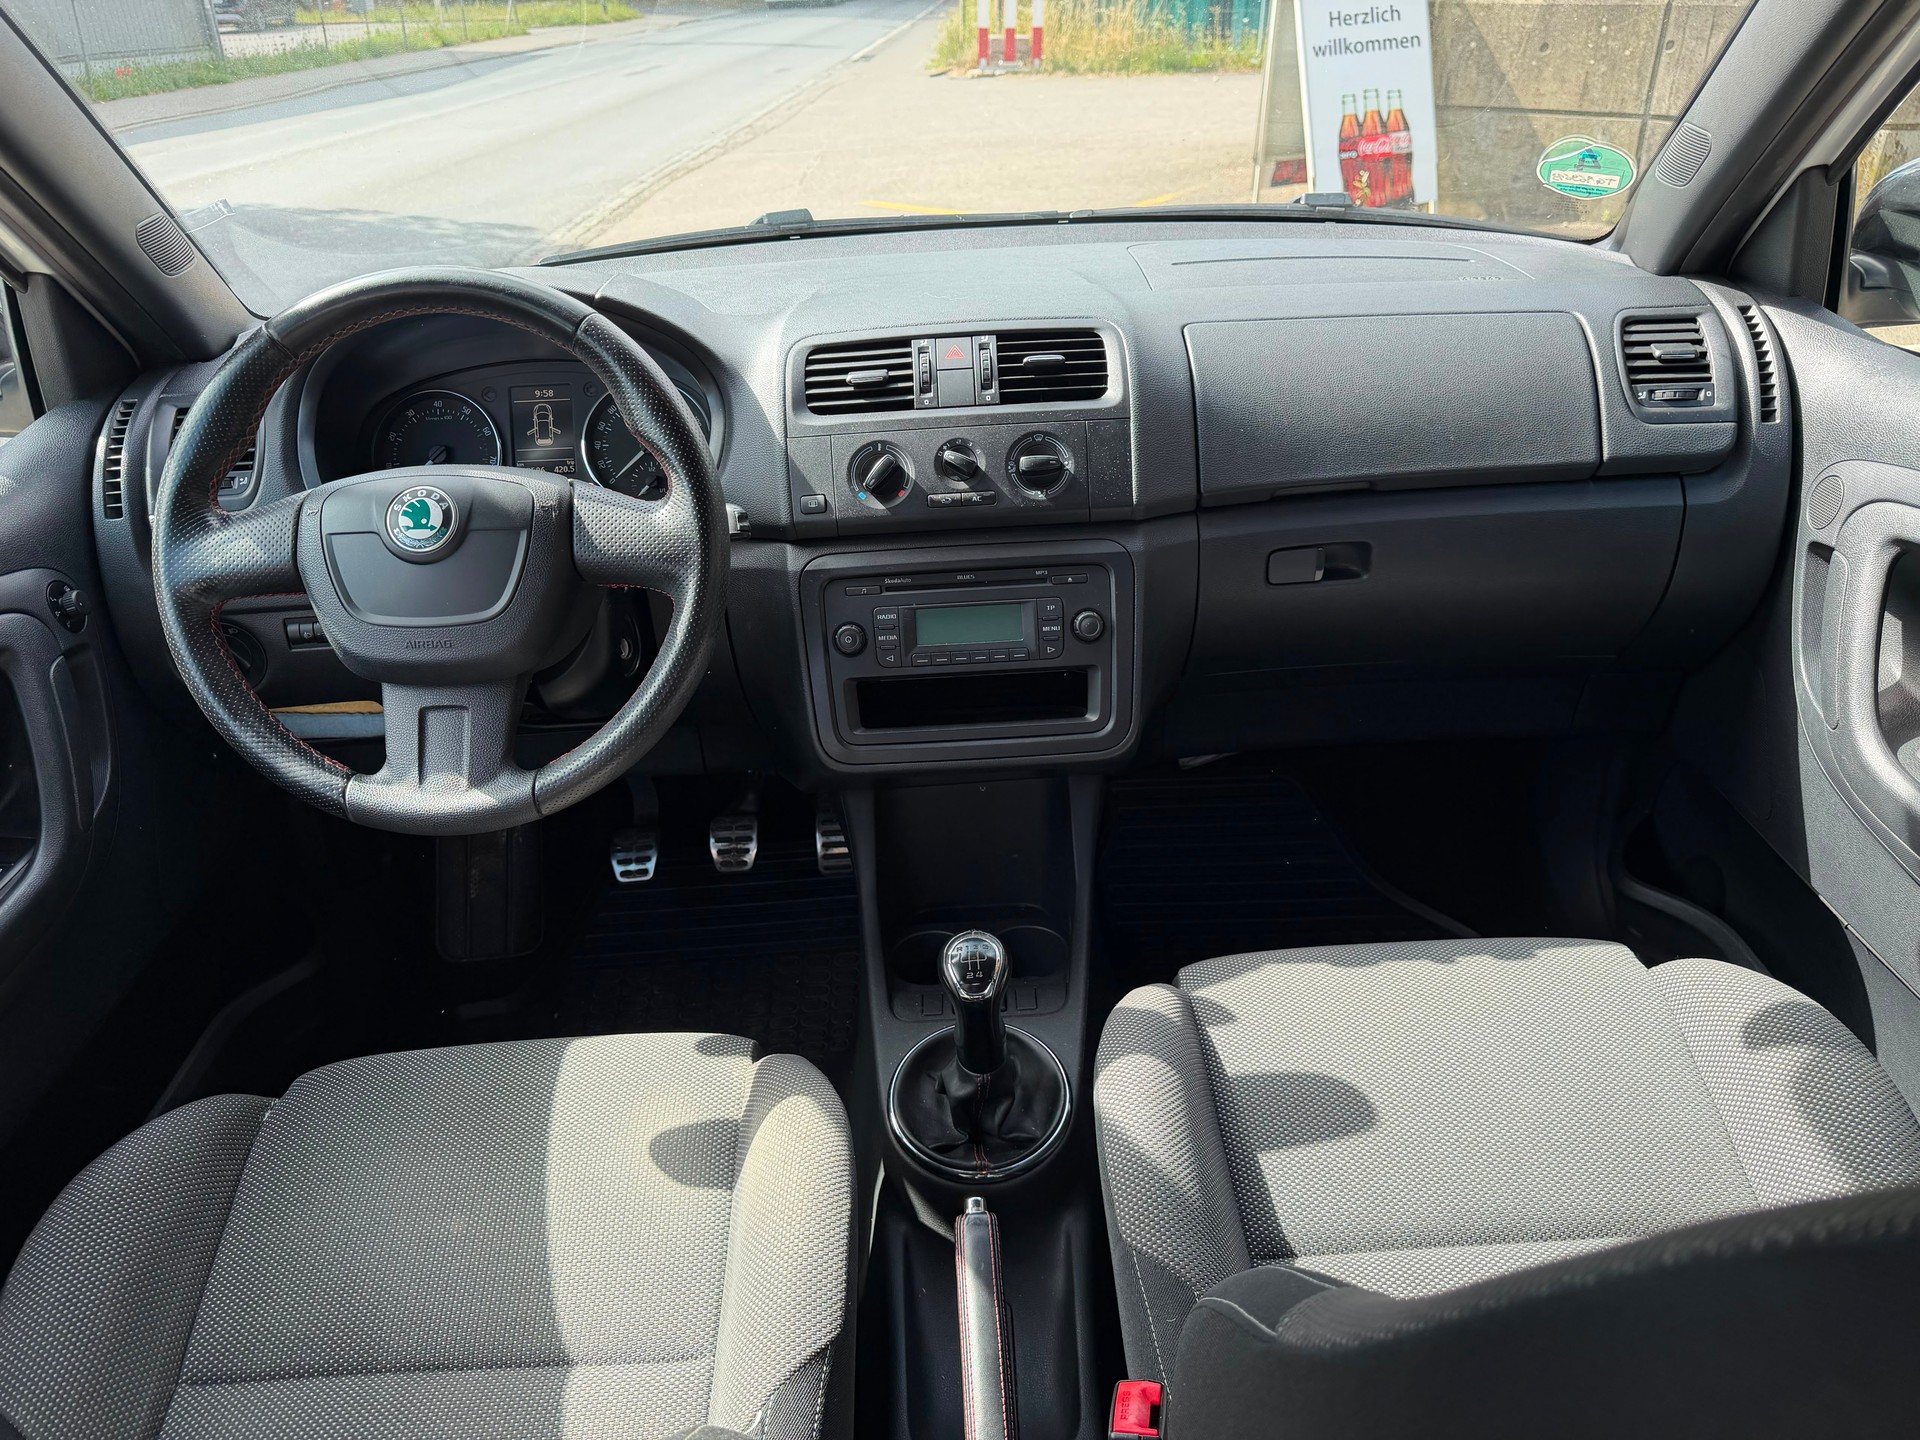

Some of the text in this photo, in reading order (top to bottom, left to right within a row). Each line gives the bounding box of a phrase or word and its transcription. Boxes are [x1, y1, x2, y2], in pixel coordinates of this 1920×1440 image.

[1328, 4, 1401, 27] Herzlich
[1312, 34, 1421, 58] willkommen
[534, 389, 554, 397] 9:58
[433, 400, 443, 408] 40
[406, 409, 415, 418] 30
[461, 405, 472, 415] 50
[607, 405, 617, 415] 80
[597, 421, 606, 431] 60
[388, 431, 397, 441] 20
[482, 426, 492, 437] 60
[594, 440, 602, 450] 40
[489, 455, 497, 466] 70
[597, 460, 606, 469] 20
[554, 465, 575, 473] 420.5
[405, 640, 452, 649] AIRBAG
[1120, 1390, 1131, 1420] PRESS
